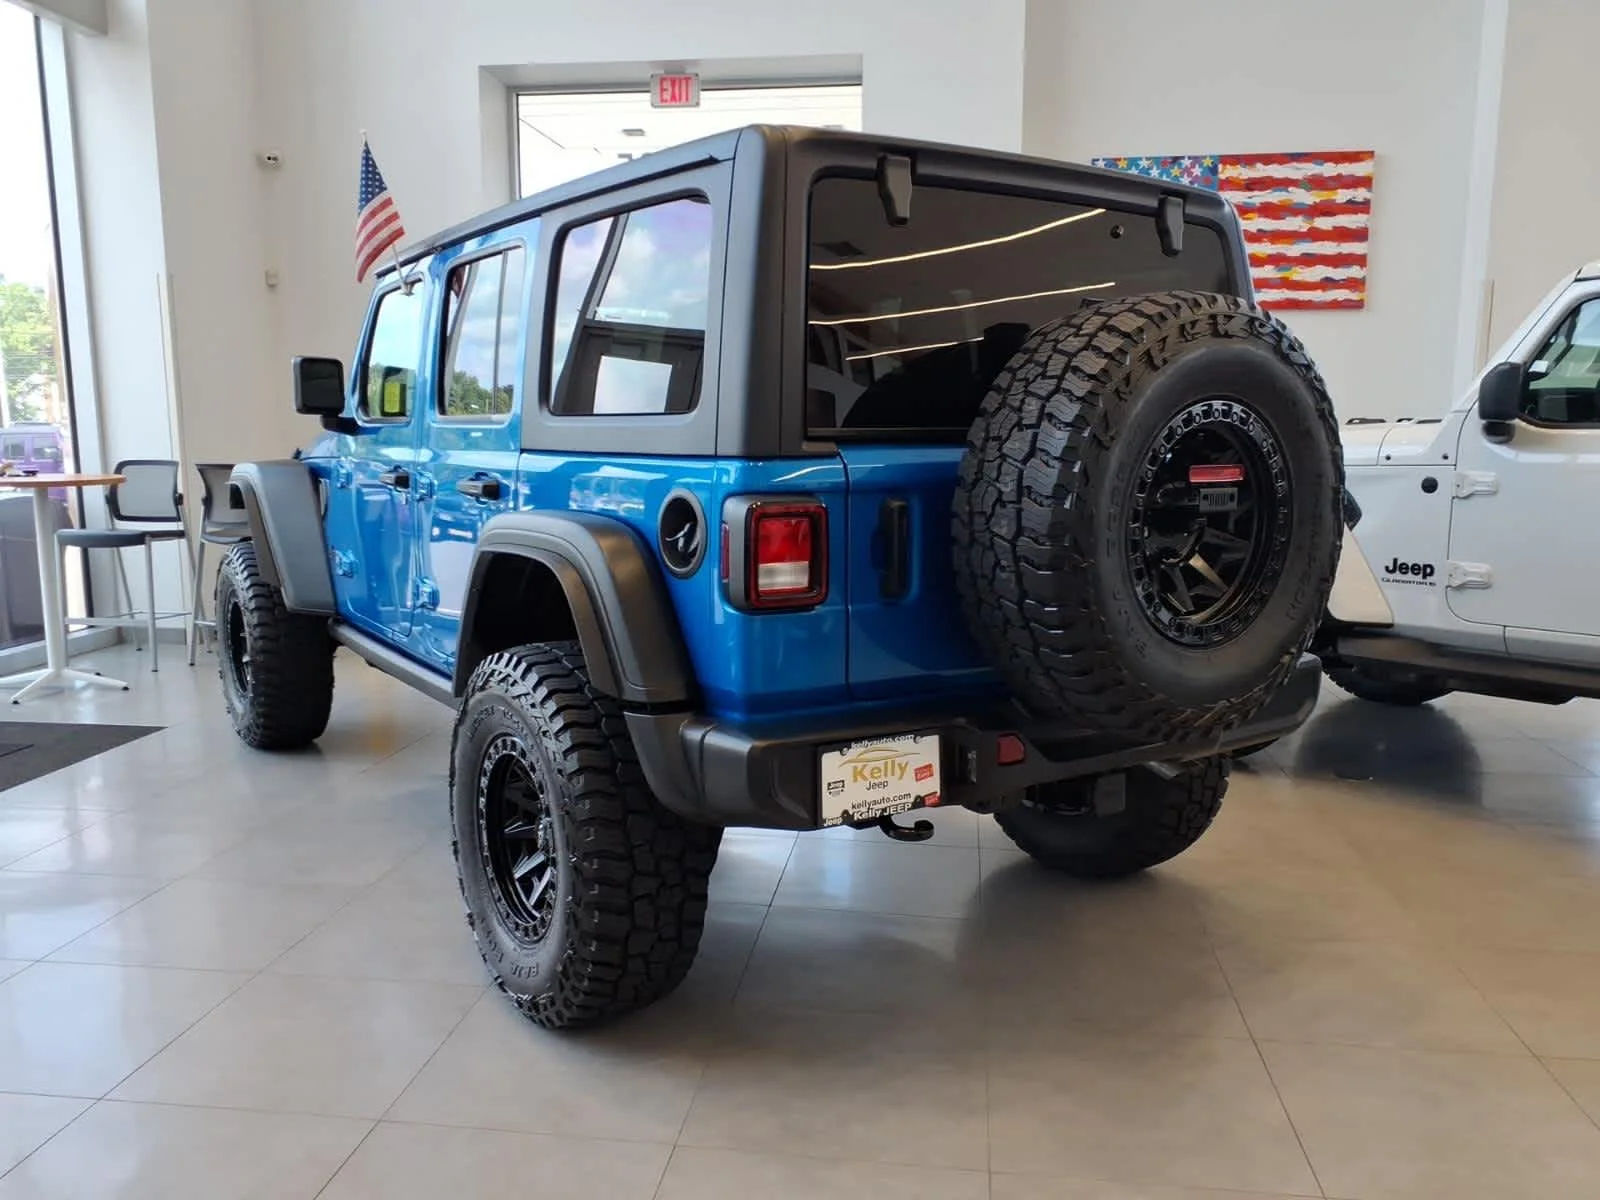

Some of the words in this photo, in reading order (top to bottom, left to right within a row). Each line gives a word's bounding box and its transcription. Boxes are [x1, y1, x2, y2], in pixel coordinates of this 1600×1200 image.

[659, 76, 692, 104] EXIT
[1385, 558, 1435, 580] Jeep
[852, 760, 909, 783] Kelly
[866, 780, 889, 791] Jeep
[851, 792, 912, 810] kellyauto.com
[853, 807, 882, 820] Kelly
[883, 802, 912, 816] JEEP
